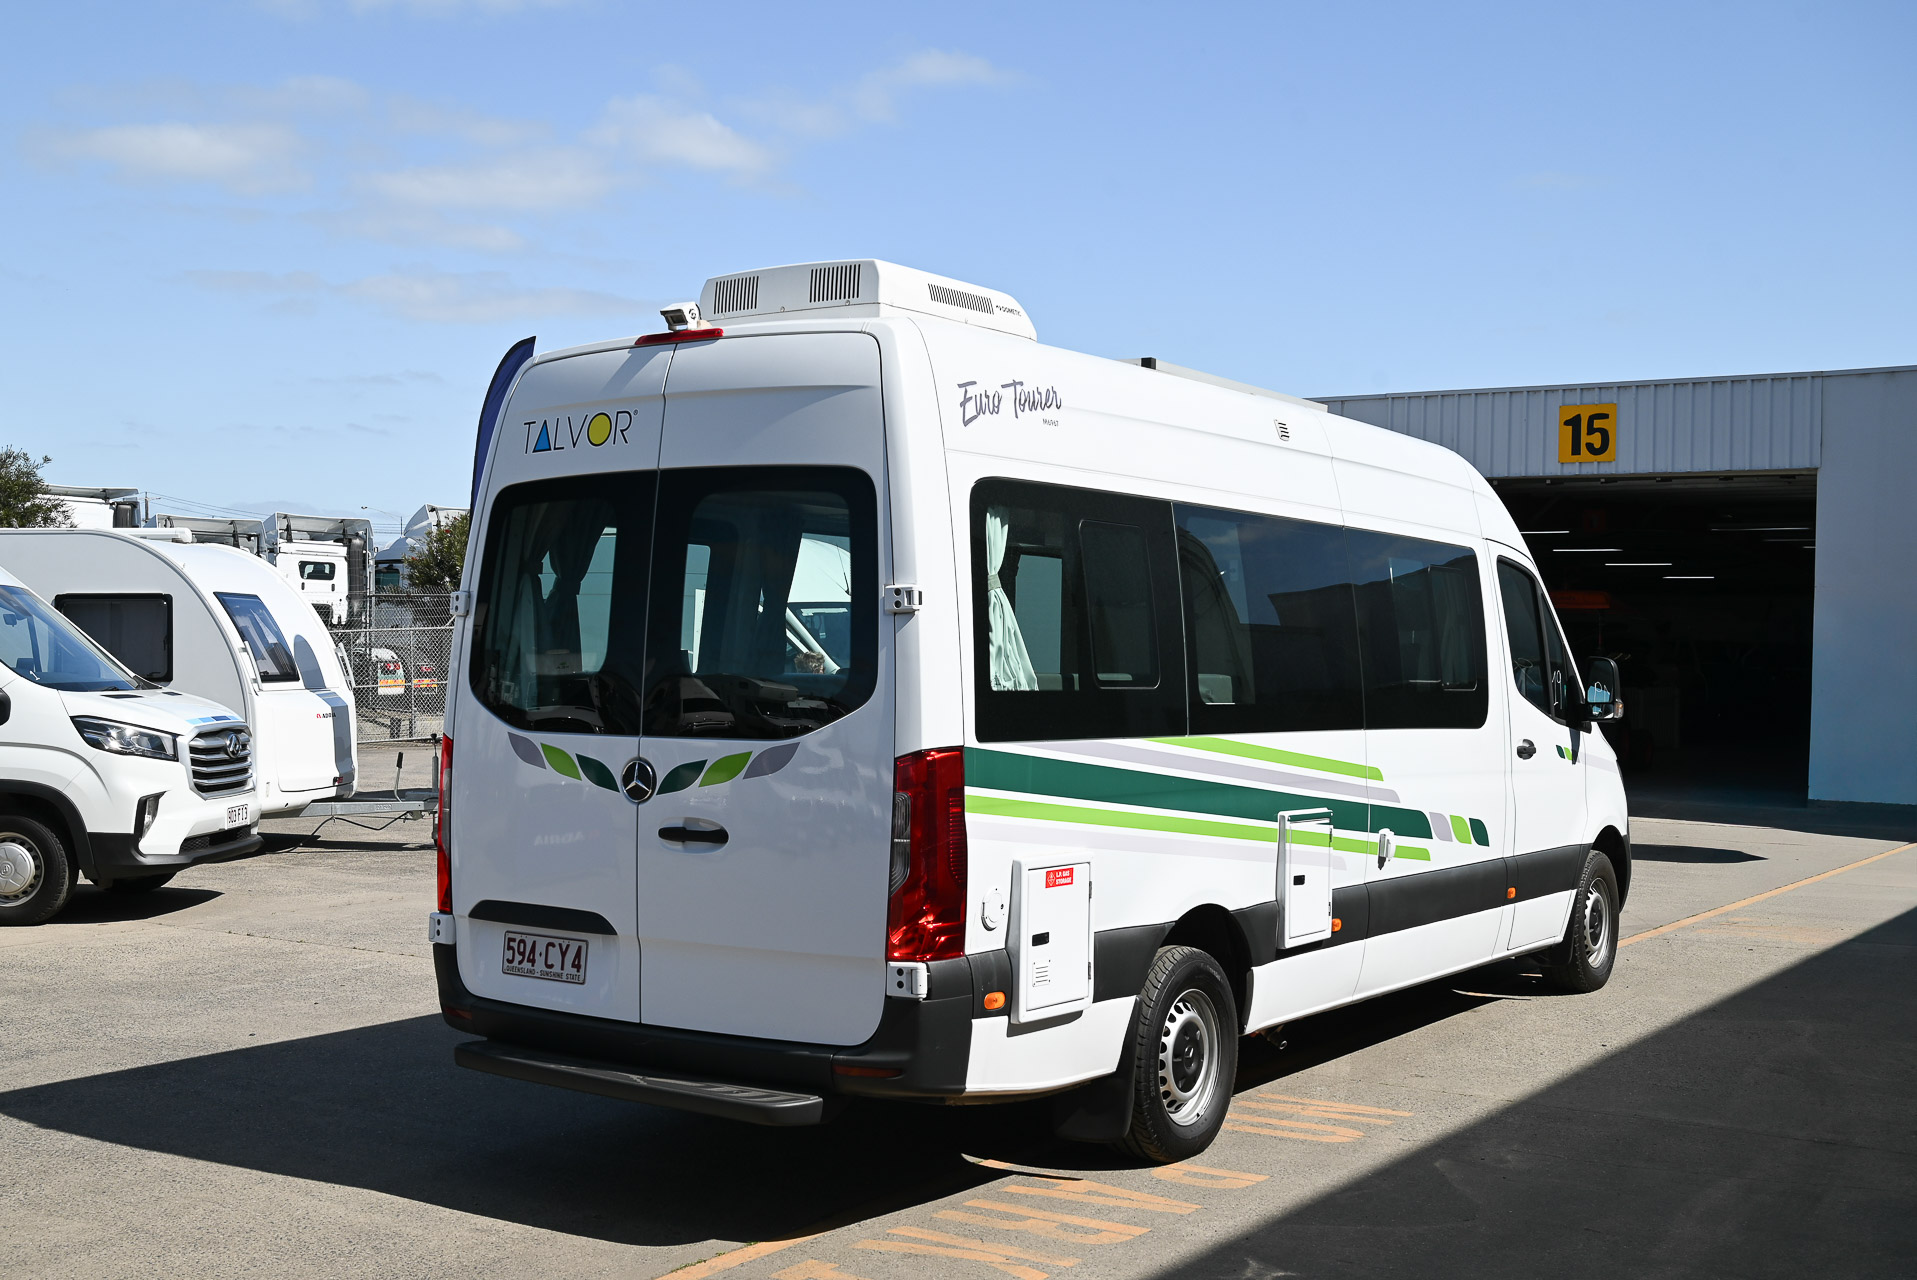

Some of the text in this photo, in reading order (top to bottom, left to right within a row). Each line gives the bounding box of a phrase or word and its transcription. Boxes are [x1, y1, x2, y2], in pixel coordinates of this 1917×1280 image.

[957, 379, 1062, 427] Euro Tourer
[1563, 413, 1610, 456] 15
[505, 965, 581, 982] QUEENSLAND SUNSHINE STATE
